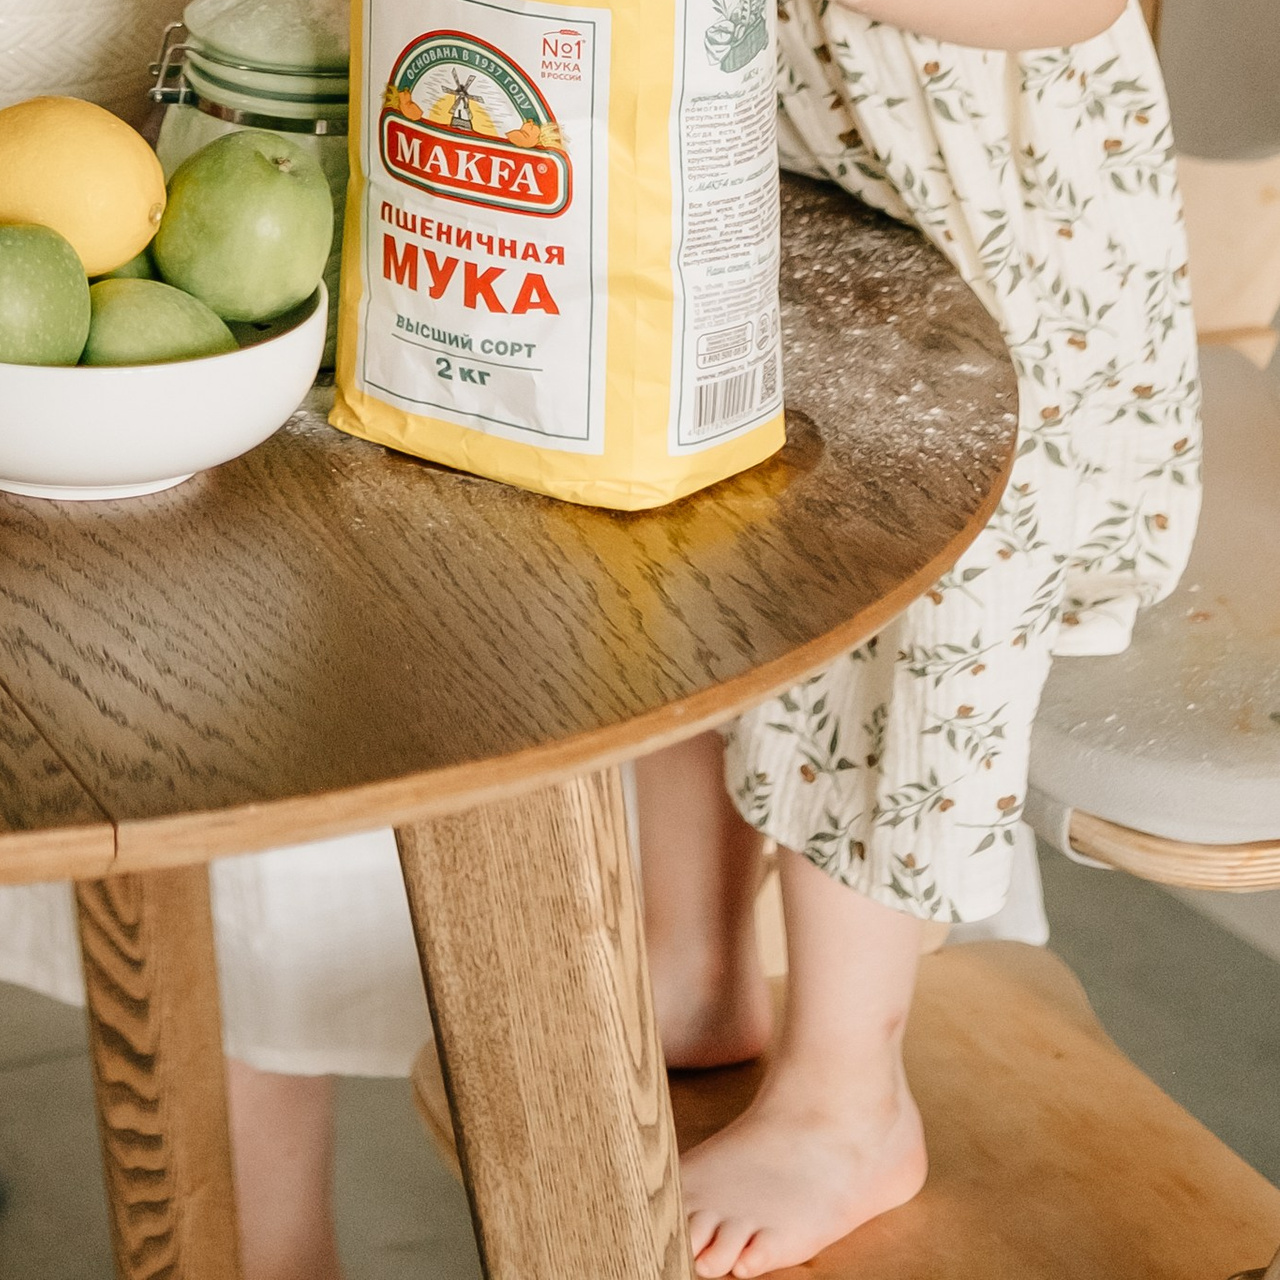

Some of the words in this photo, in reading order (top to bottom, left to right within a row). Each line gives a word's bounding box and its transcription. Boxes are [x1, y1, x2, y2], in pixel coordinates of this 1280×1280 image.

[406, 47, 458, 80] ОСНОВАНА
[462, 49, 470, 61] В
[475, 54, 503, 77] 1937
[503, 76, 532, 110] ГОДУ
[541, 60, 581, 73] МУКА
[547, 72, 582, 82] РОССИИ
[380, 200, 566, 267] ПШЕНИЧНАЯ
[383, 233, 561, 316] МУКА
[395, 313, 473, 352] ВЫСШИЙ
[480, 338, 536, 359] СОРТ
[435, 356, 453, 381] 2
